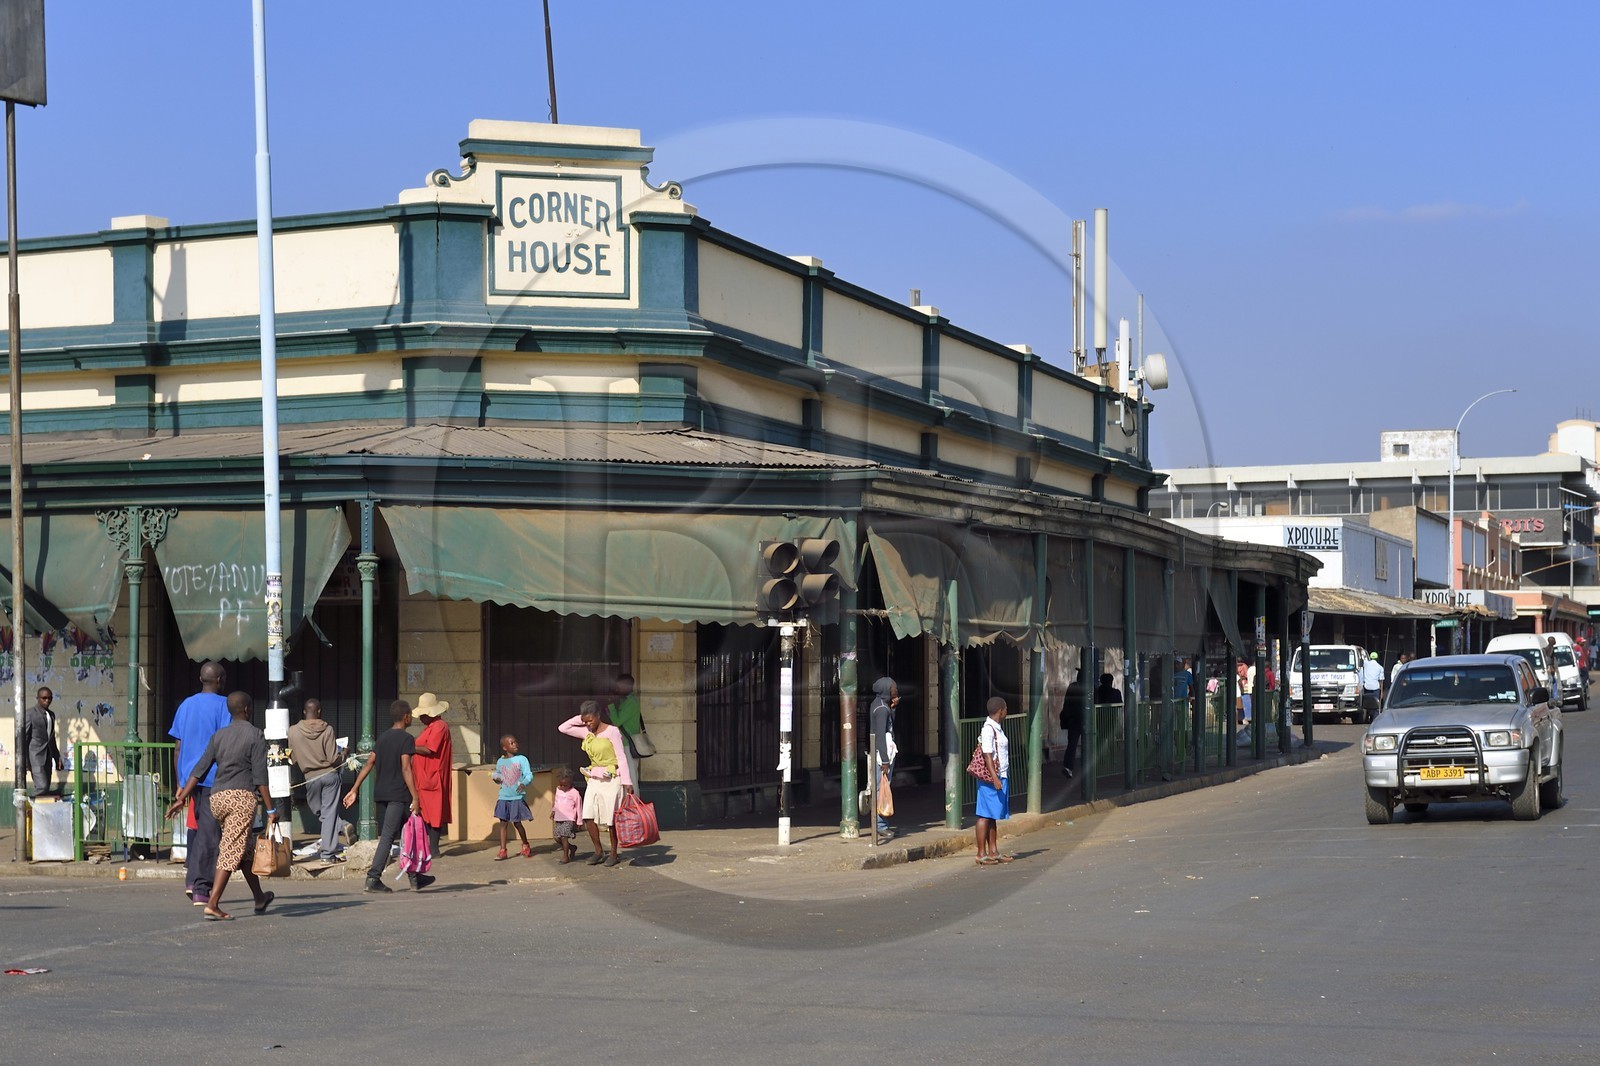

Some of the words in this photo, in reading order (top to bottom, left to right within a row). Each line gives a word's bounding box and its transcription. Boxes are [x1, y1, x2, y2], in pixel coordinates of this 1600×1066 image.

[509, 191, 611, 237] CORNER
[508, 240, 611, 276] HOUSE
[1287, 527, 1339, 545] XPOSURE
[205, 562, 265, 596] ZANU
[1425, 591, 1472, 607] XPOSRE
[1426, 769, 1441, 778] ABP
[1443, 768, 1463, 778] 3391
